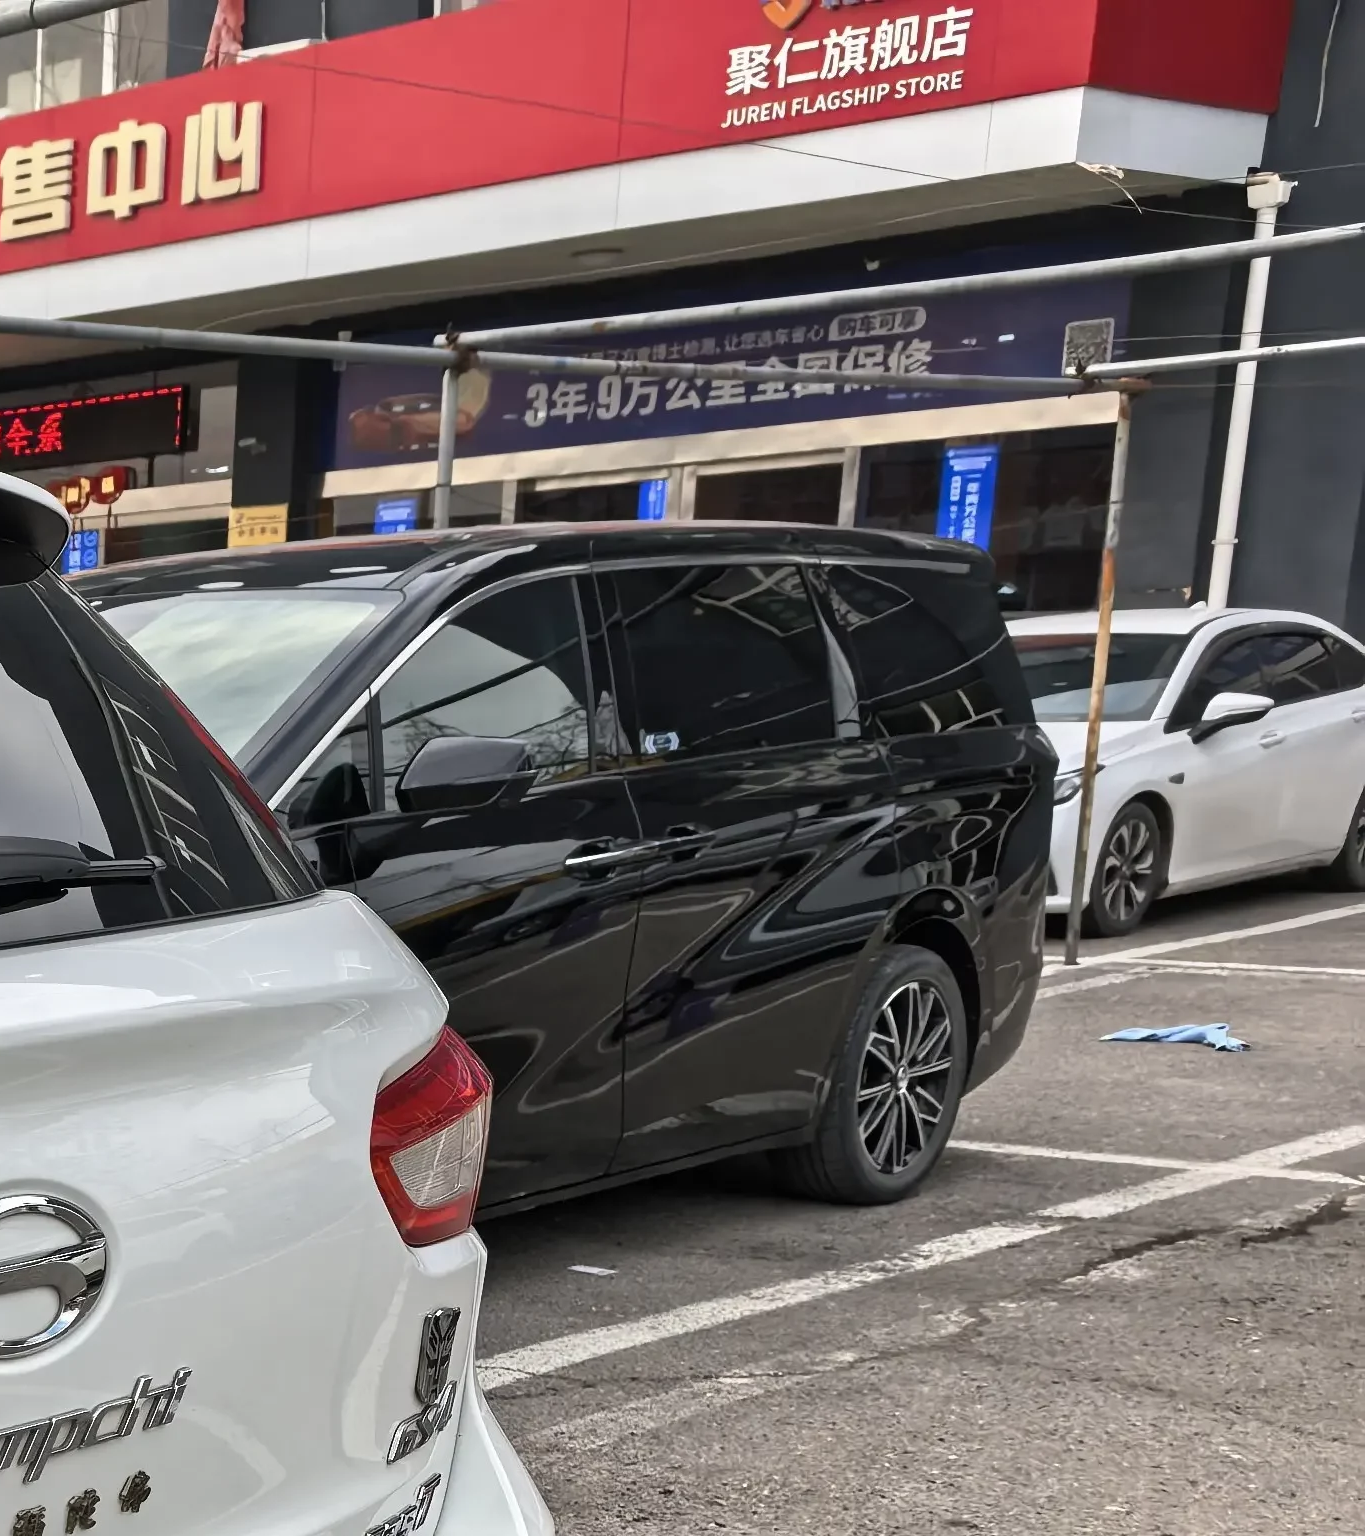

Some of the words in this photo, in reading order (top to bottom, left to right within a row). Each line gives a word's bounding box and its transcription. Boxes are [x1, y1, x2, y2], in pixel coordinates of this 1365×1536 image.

[725, 6, 974, 95] 聚仁旗舰店
[721, 101, 786, 129] JUREN
[791, 83, 890, 117] FLAGSHIP
[894, 69, 965, 99] STORE
